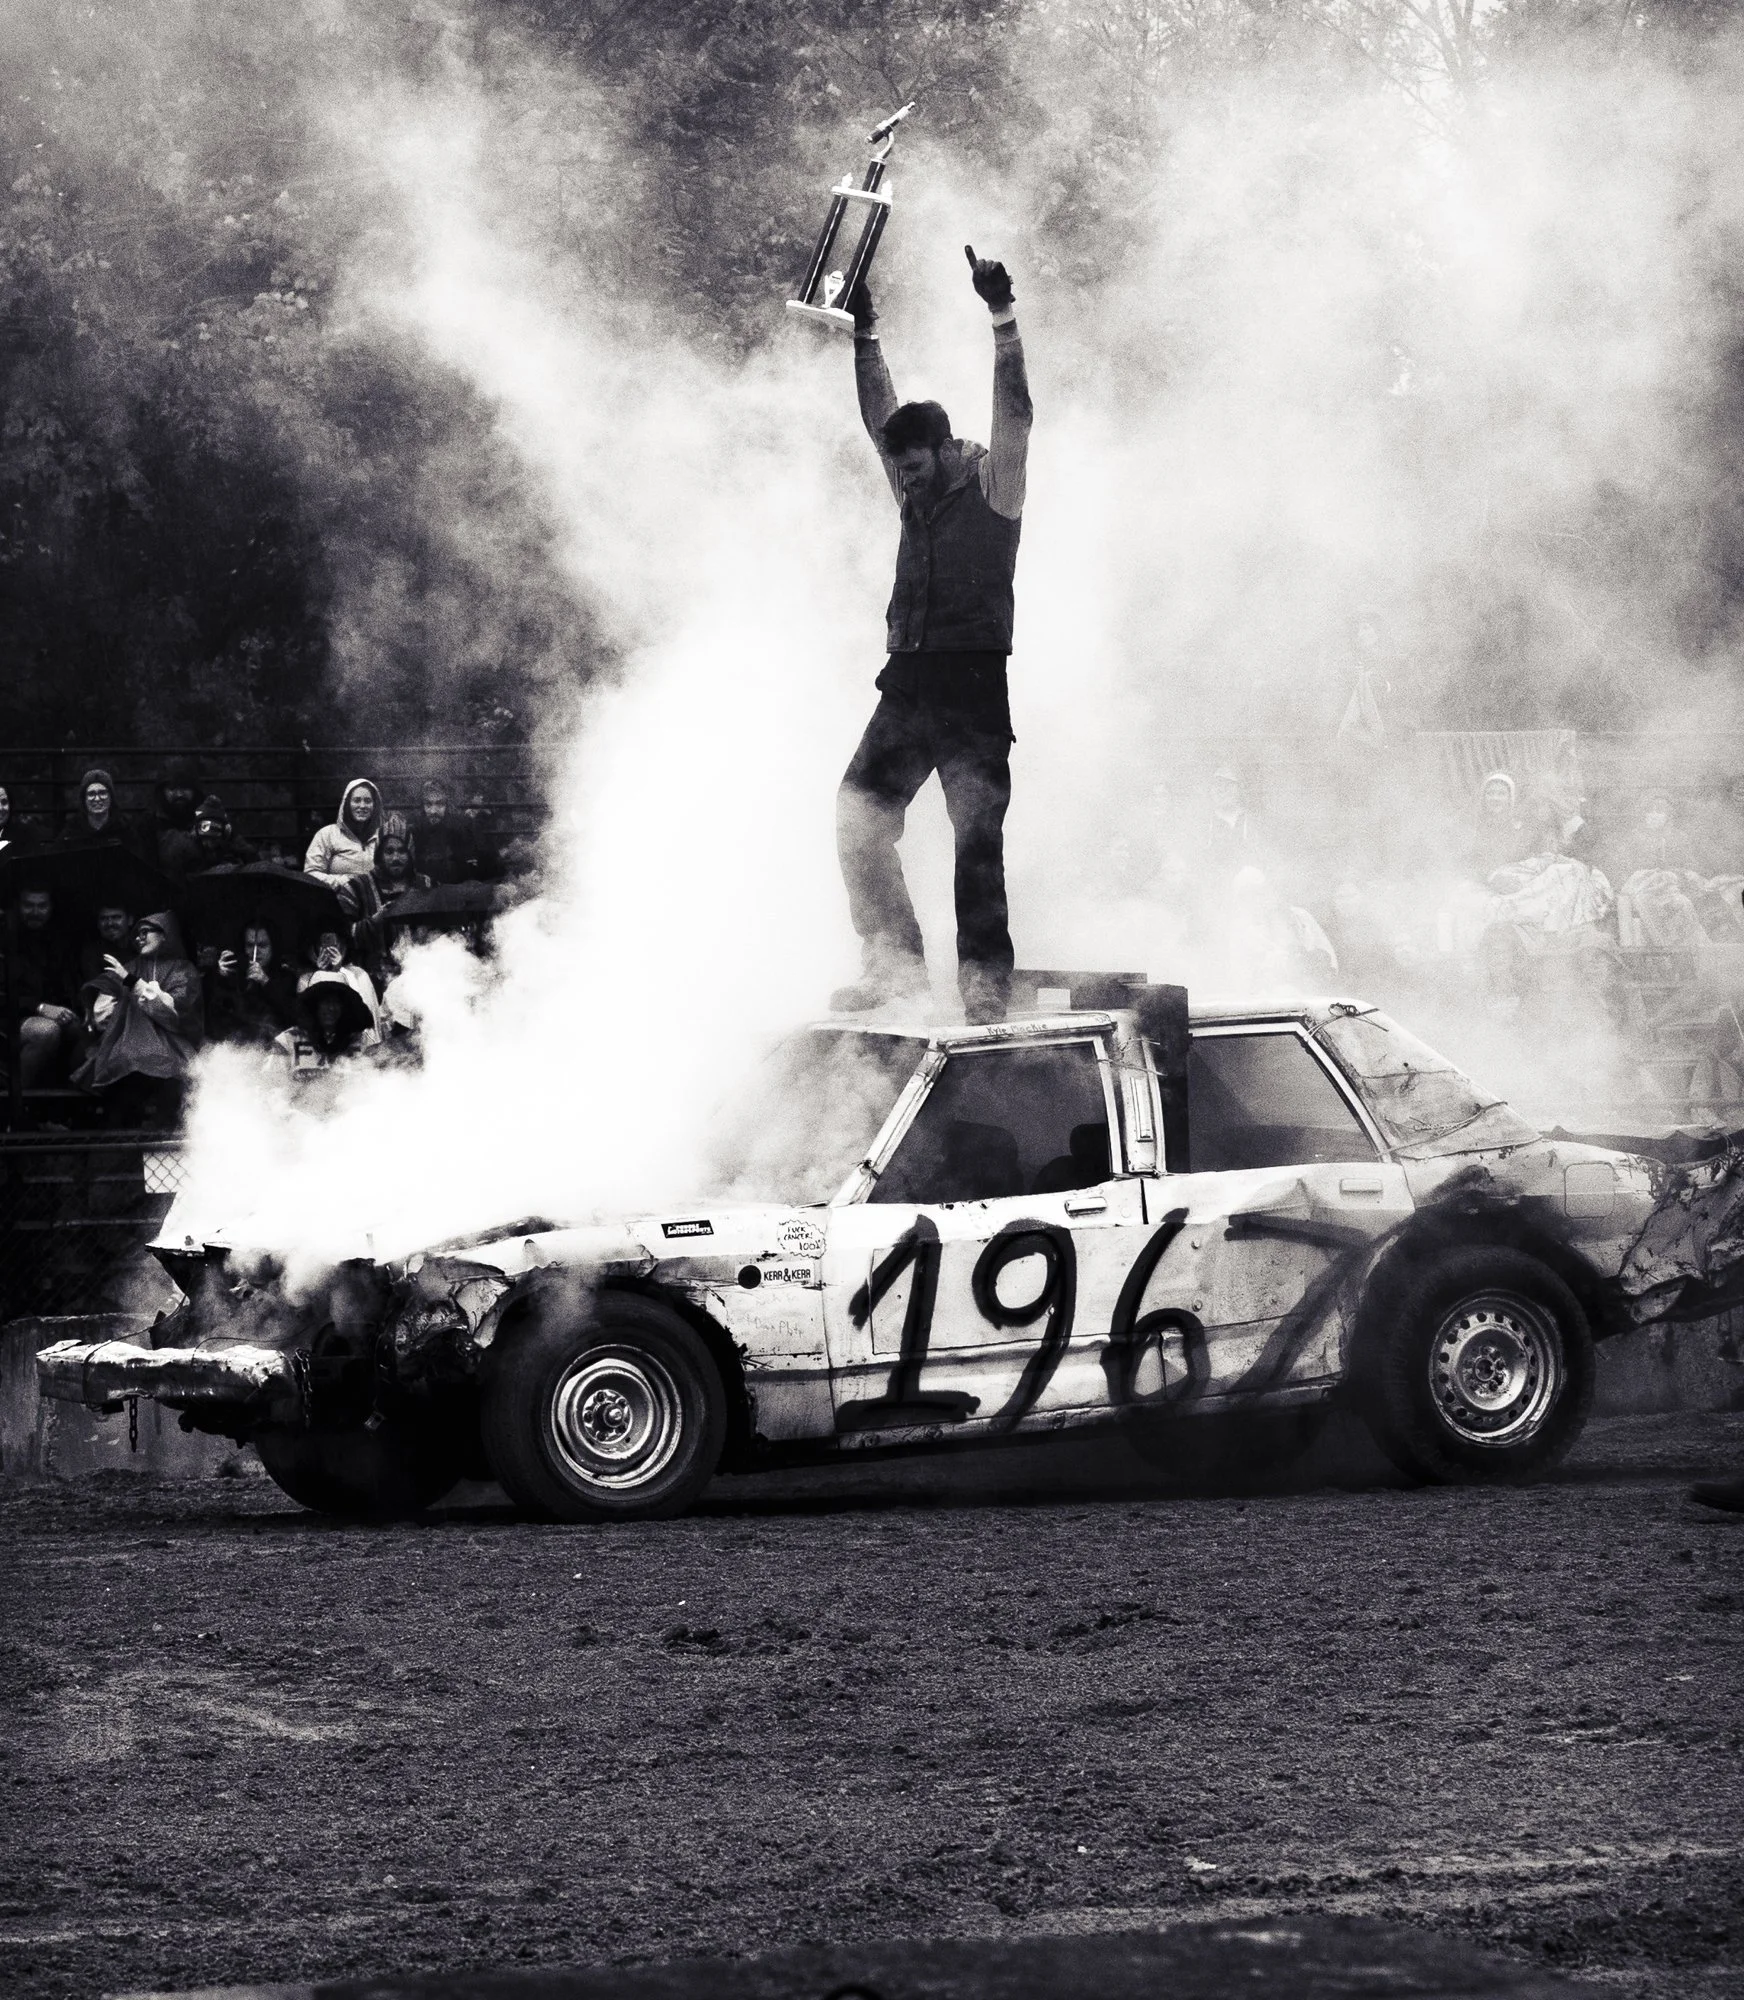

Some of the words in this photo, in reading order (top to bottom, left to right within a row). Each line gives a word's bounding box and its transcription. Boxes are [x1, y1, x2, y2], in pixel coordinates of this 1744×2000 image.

[763, 1270, 783, 1281] KERR
[783, 1268, 792, 1282] &
[791, 1269, 811, 1279] KERR
[836, 1207, 1373, 1434] 1967
